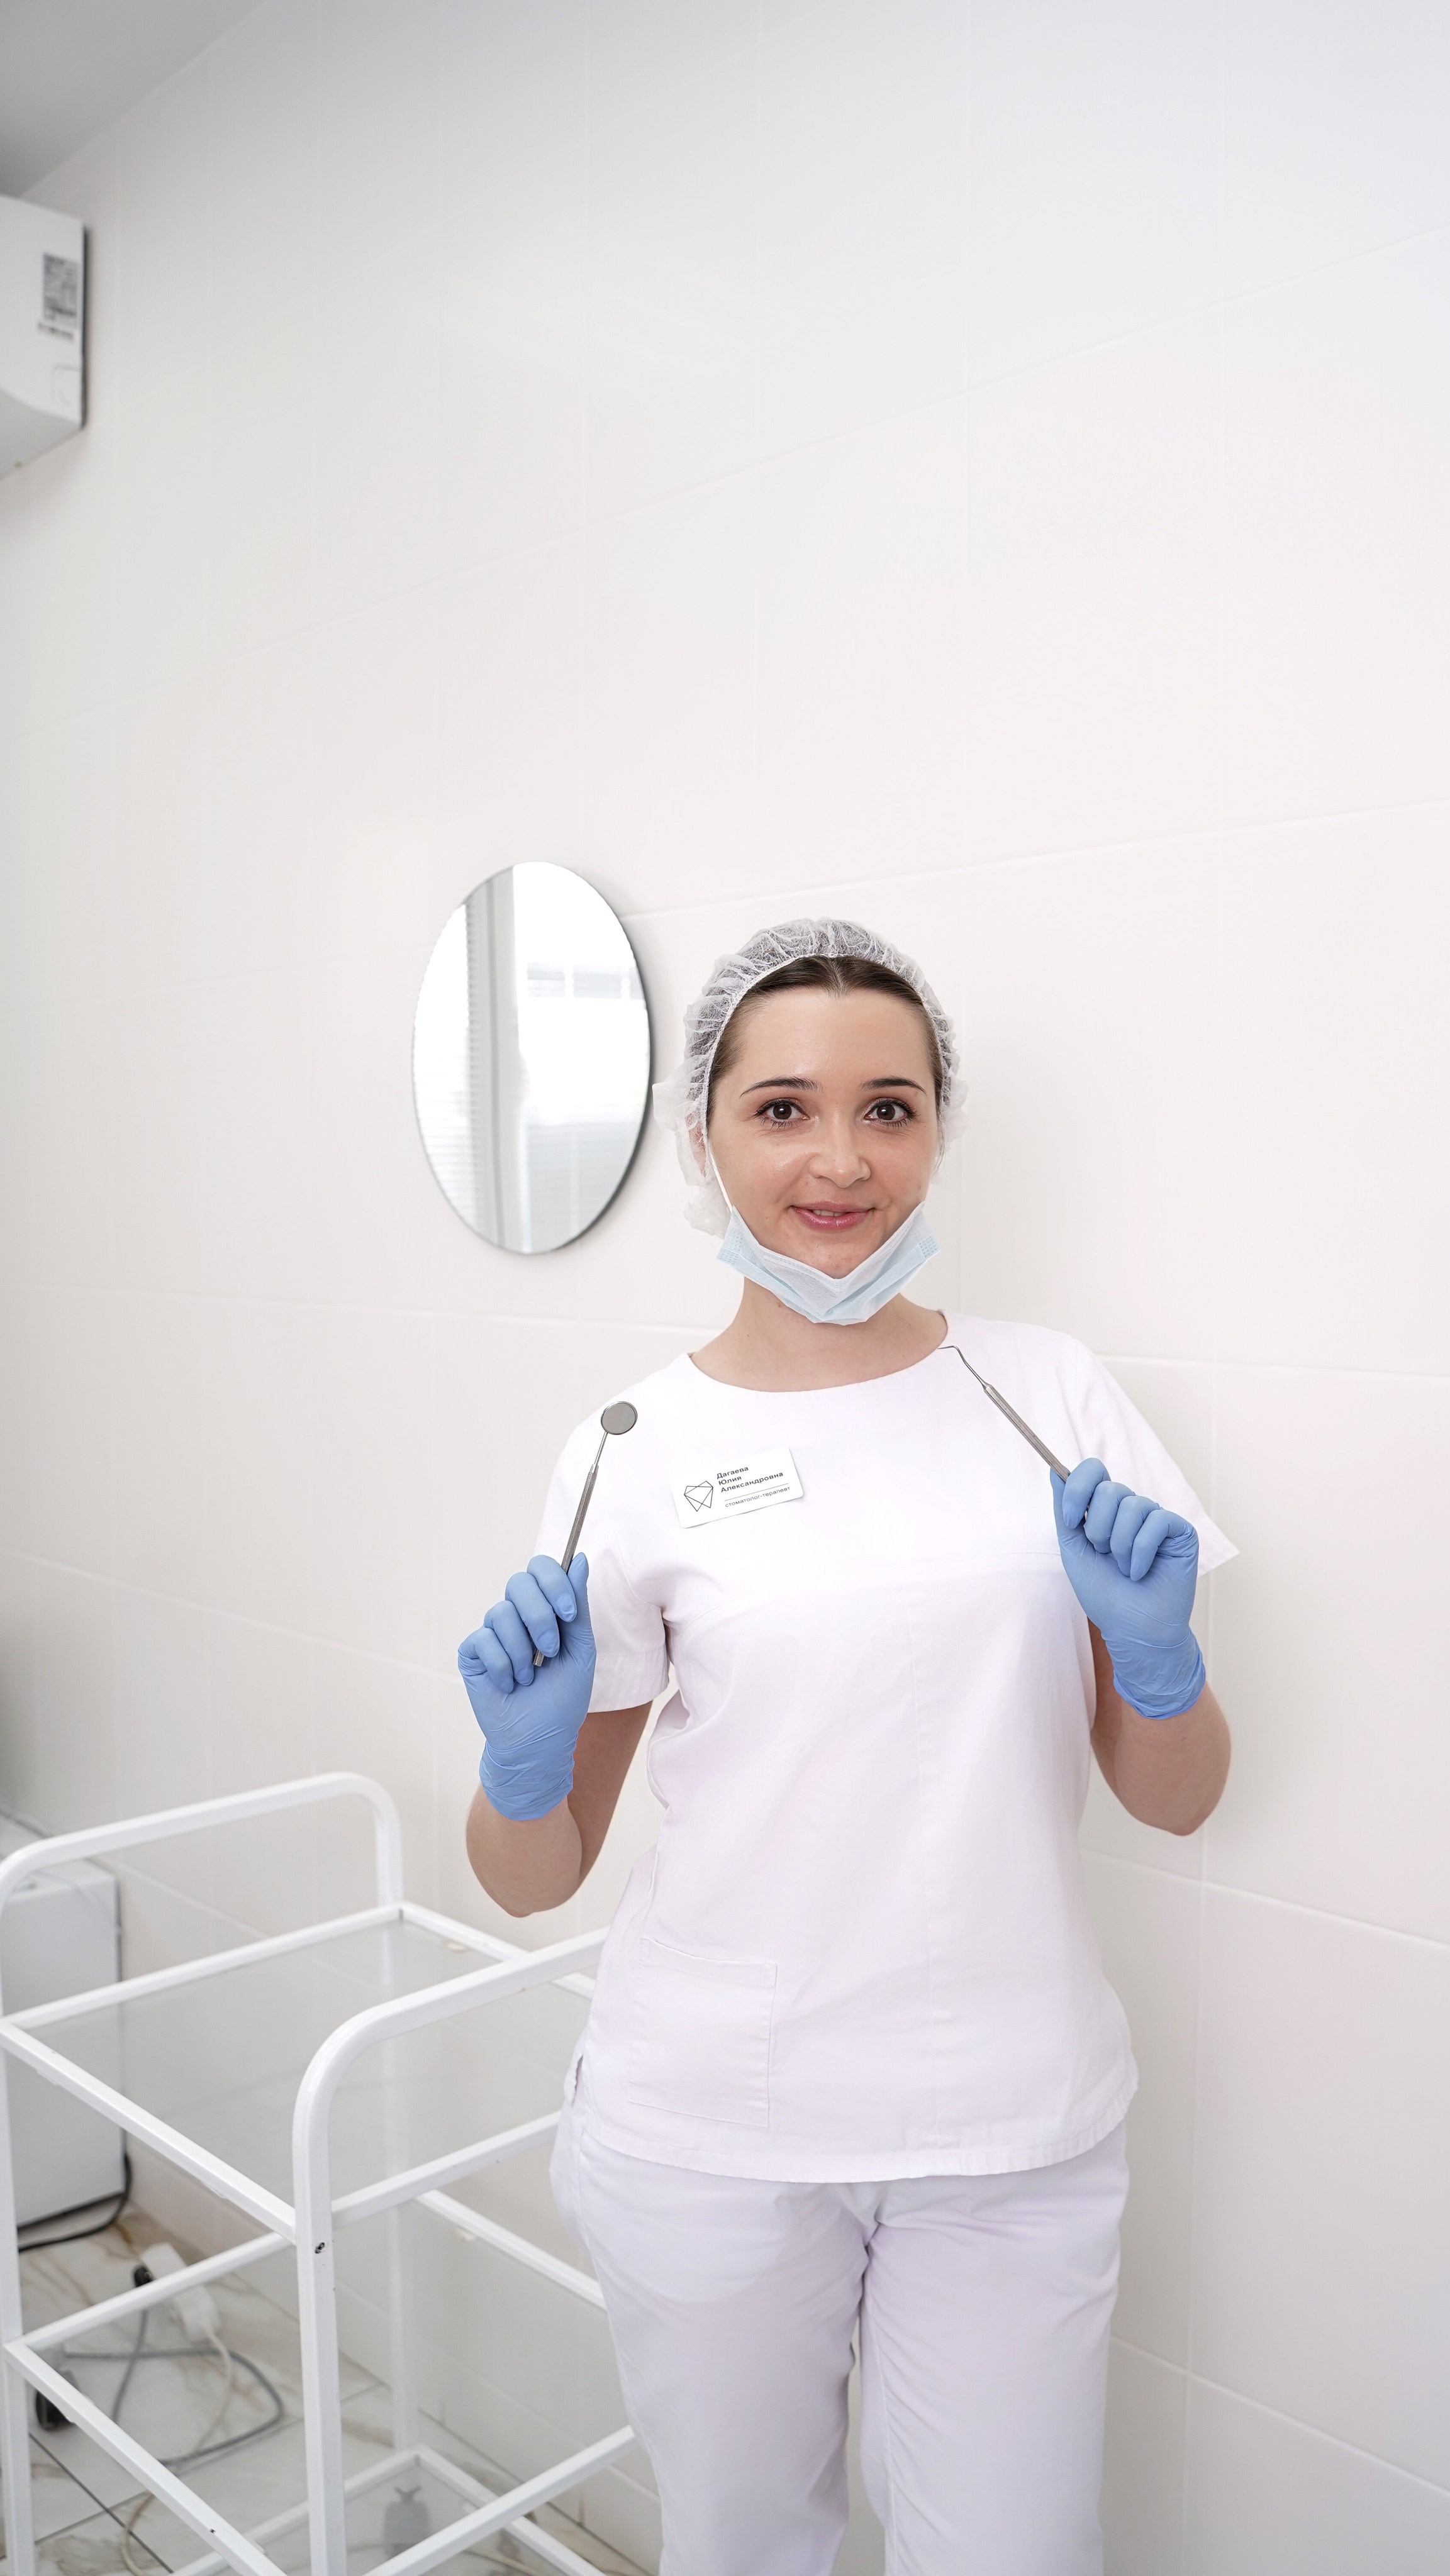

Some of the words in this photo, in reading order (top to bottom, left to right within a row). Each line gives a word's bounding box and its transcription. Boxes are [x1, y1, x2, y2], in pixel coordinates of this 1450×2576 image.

[717, 1467, 749, 1479] Дагаева
[718, 1476, 742, 1485] Юлия
[721, 1472, 783, 1492] Александровна
[725, 1487, 791, 1507] стоматолог-терапевт
